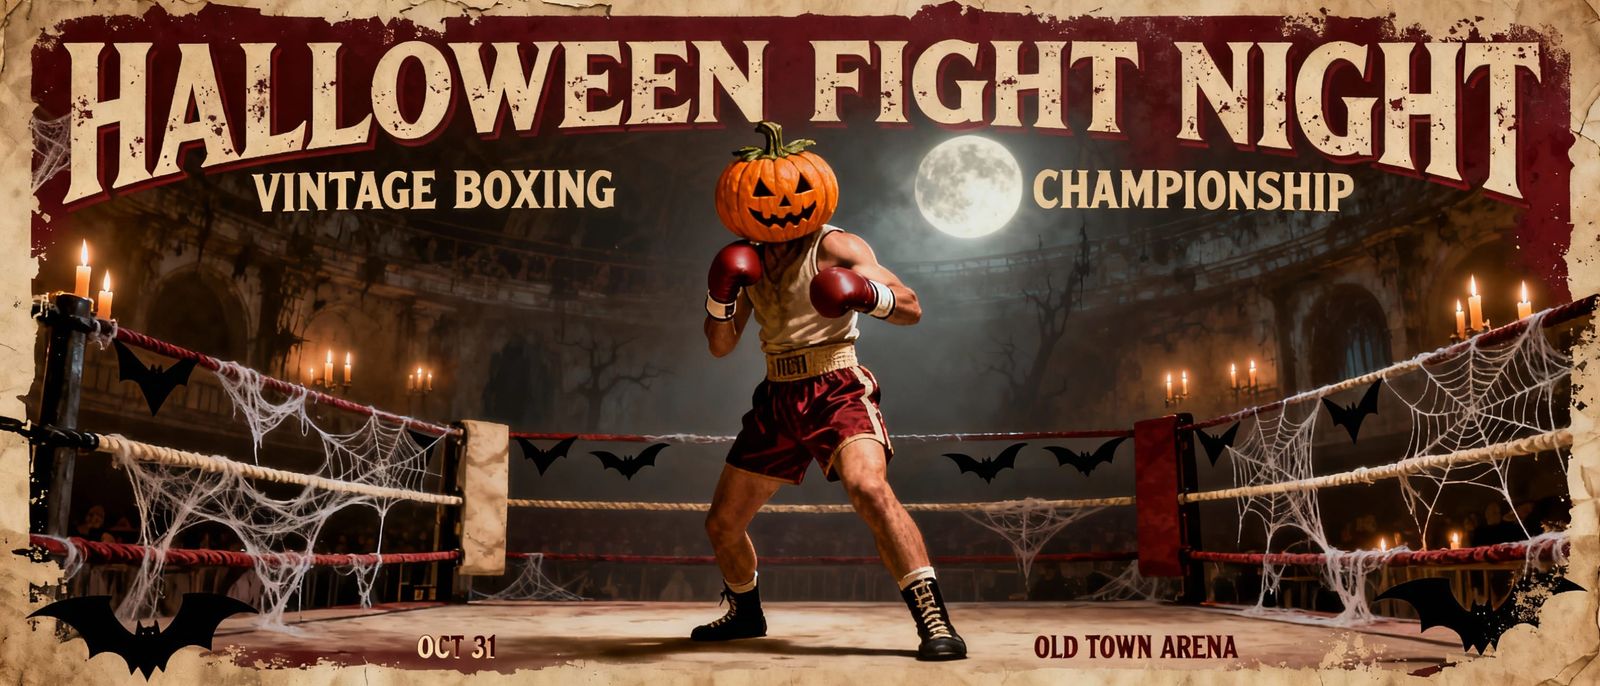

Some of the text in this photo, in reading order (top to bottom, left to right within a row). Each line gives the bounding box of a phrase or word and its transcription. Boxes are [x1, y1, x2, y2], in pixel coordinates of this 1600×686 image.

[62, 39, 1542, 205] HALLOWEEN FIGHT NIGHT
[251, 169, 616, 213] VINTAGE BOXING
[1033, 169, 1355, 213] CHAMPIONSHIP
[417, 634, 496, 659] OCT 31
[1034, 634, 1239, 659] OLD TOWN ARENA
